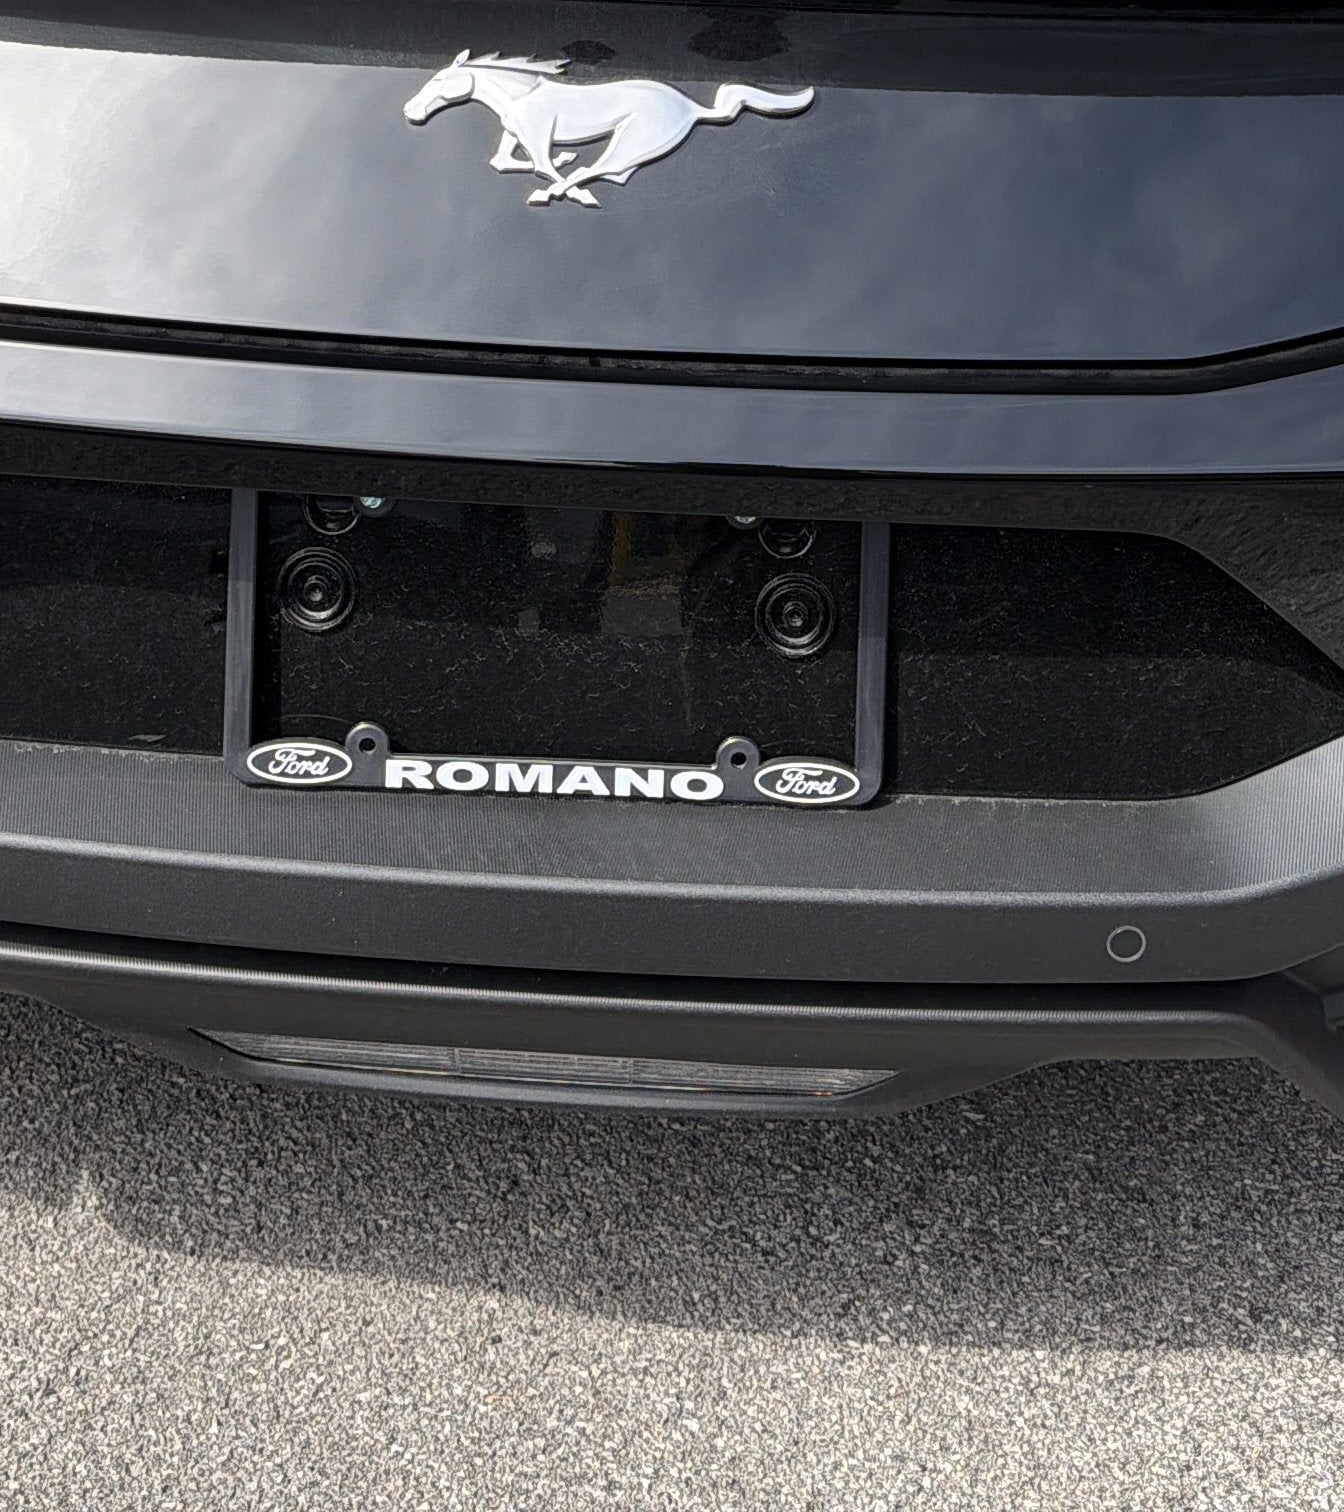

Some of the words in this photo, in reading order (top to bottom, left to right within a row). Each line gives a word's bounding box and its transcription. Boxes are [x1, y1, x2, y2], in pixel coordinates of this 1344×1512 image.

[268, 748, 331, 775] Ford
[385, 759, 724, 800] ROMANO
[776, 768, 838, 795] Ford
